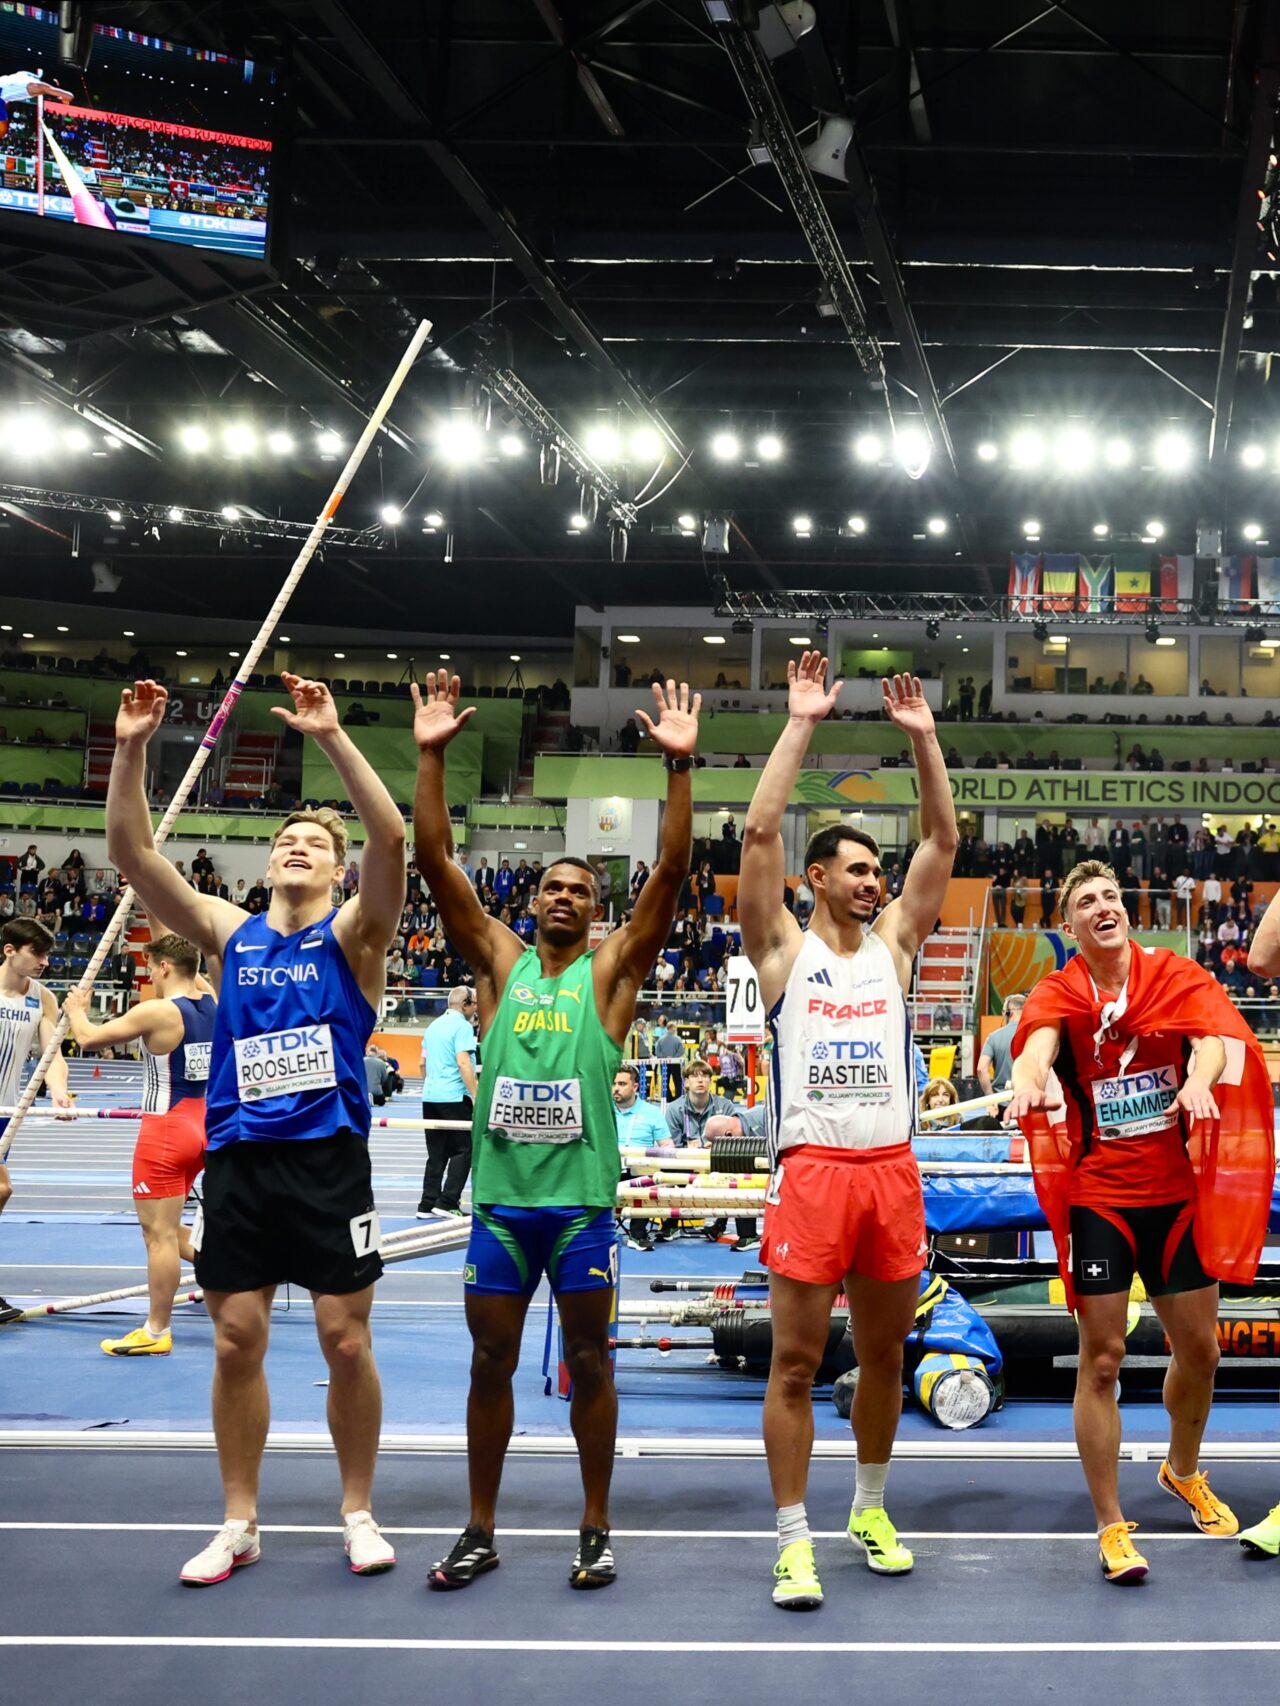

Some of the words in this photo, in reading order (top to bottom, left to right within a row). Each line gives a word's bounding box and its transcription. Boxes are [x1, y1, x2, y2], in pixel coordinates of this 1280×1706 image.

[106, 111, 172, 137] WELCOME
[173, 124, 192, 138] TO
[191, 215, 229, 231] TDK
[910, 776, 1018, 800] ORLD
[1025, 778, 1185, 802] ATHLETICS
[237, 963, 320, 987] ESTONIA
[94, 991, 124, 1013] T1
[728, 977, 757, 1013] 70
[807, 998, 888, 1020] FRANCE
[197, 1044, 212, 1055] TD
[261, 1028, 323, 1055] TDK
[828, 1041, 884, 1060] TDK
[241, 1050, 328, 1084] ROOSLEHT
[808, 1064, 888, 1085] BASTIEN
[513, 1082, 574, 1102] TDK
[1120, 1069, 1172, 1096] TDK
[493, 1103, 578, 1126] FERREIRA
[358, 1219, 372, 1249] 7
